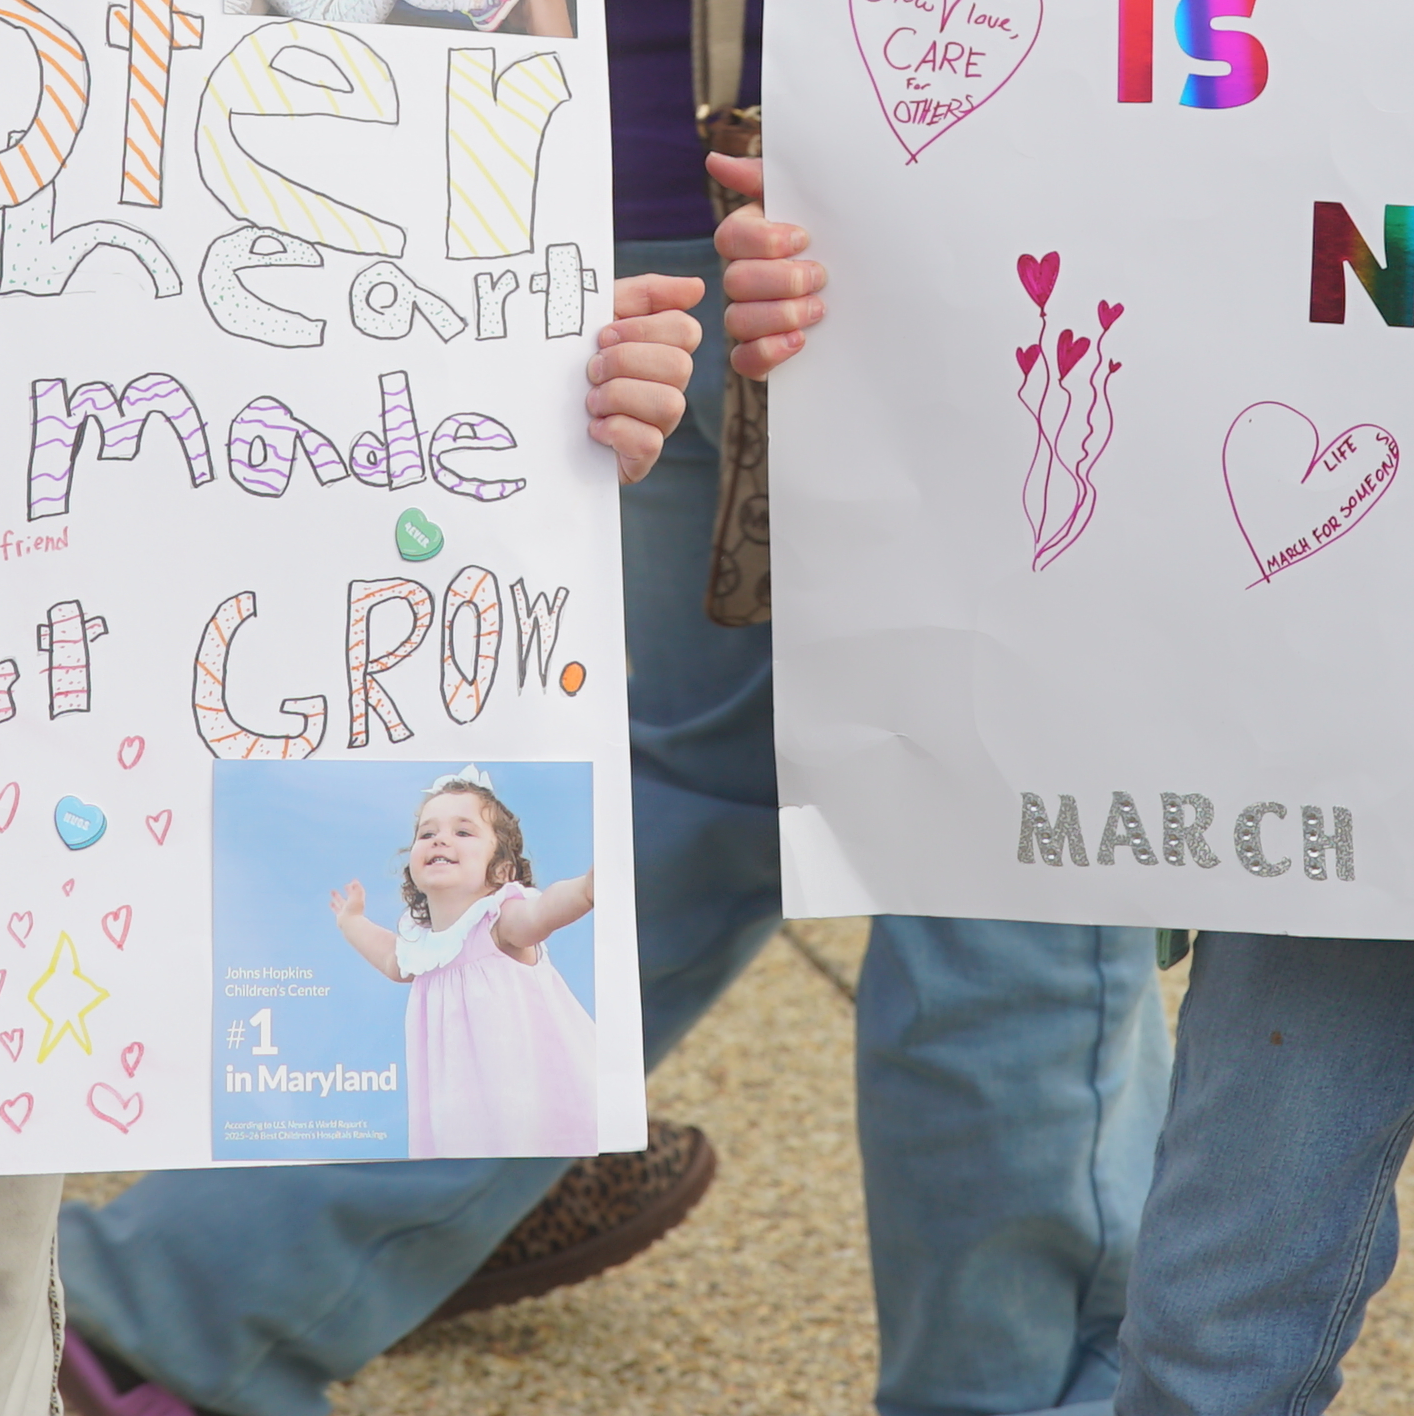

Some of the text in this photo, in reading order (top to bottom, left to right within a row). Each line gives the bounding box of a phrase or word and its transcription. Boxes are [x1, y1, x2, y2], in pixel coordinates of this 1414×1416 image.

[884, 27, 986, 78] CARE
[894, 94, 975, 126] OTHERS
[28, 370, 527, 522] made
[1323, 434, 1357, 472] LIFE
[1312, 515, 1342, 544] FOR
[1267, 537, 1311, 573] MARCH
[1017, 791, 1356, 882] MARCH
[224, 984, 331, 997] Children's Center
[225, 966, 313, 981] Johns Hopkins
[226, 1008, 278, 1055] #1
[226, 1063, 397, 1097] in Maryland
[224, 1121, 263, 1131] According
